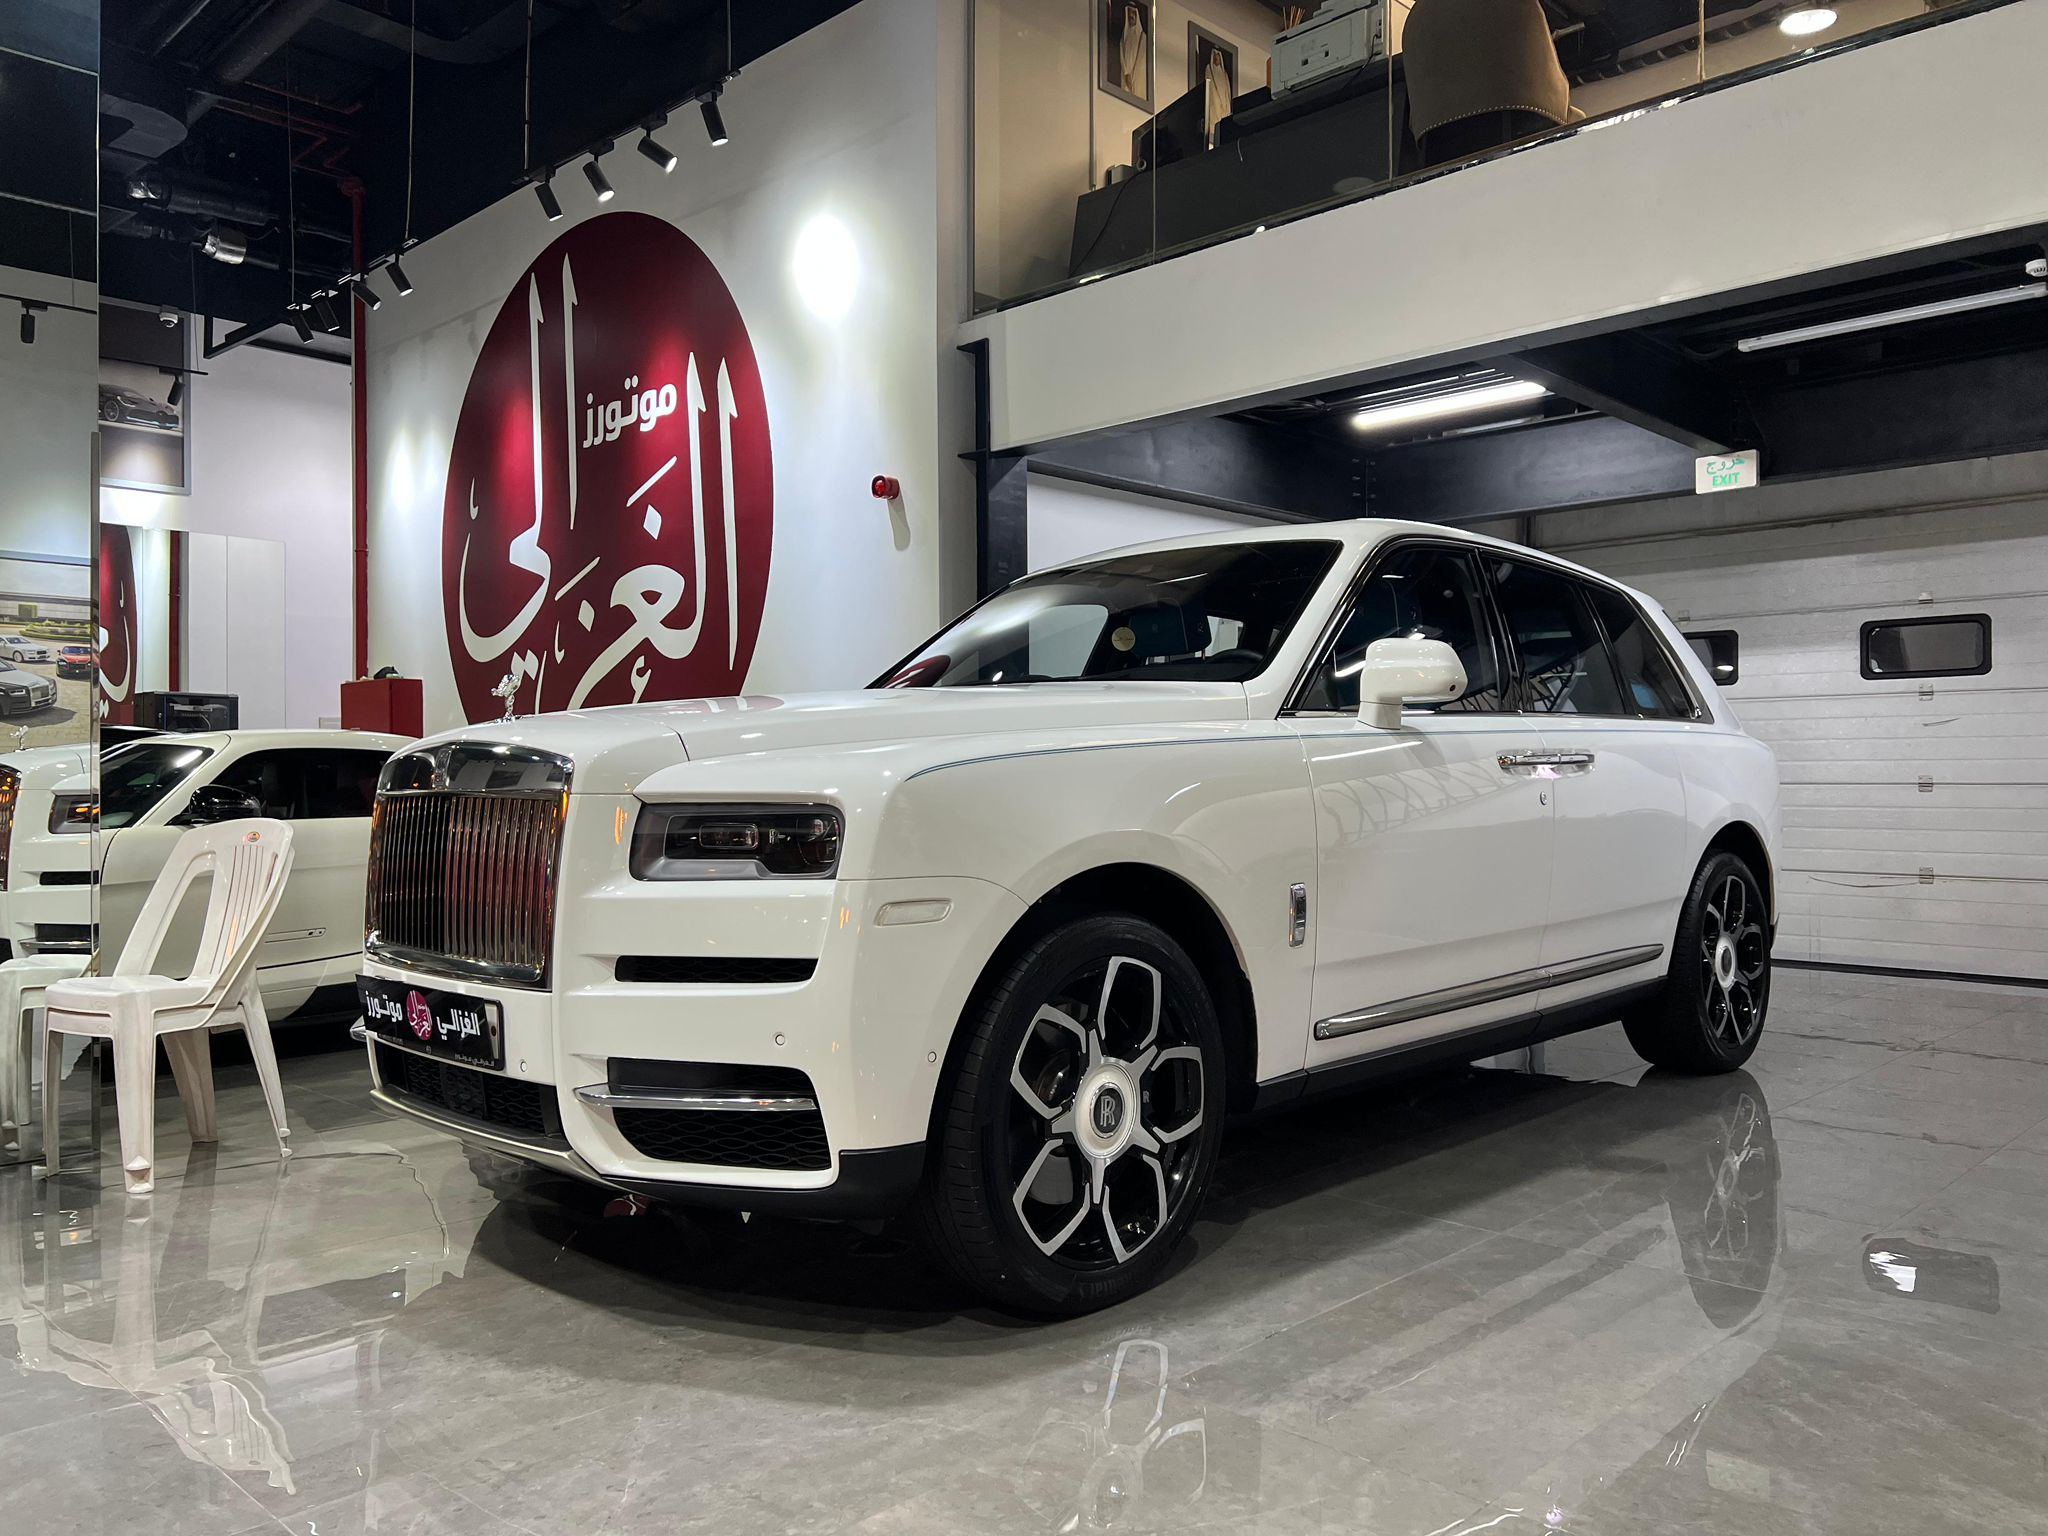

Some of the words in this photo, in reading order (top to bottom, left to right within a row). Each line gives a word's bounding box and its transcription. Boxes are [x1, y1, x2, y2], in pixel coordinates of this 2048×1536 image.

[582, 375, 677, 449] موتورز
[1712, 472, 1740, 487] EXIT
[365, 990, 403, 1023] موتورز
[436, 1008, 481, 1041] الغزالي
